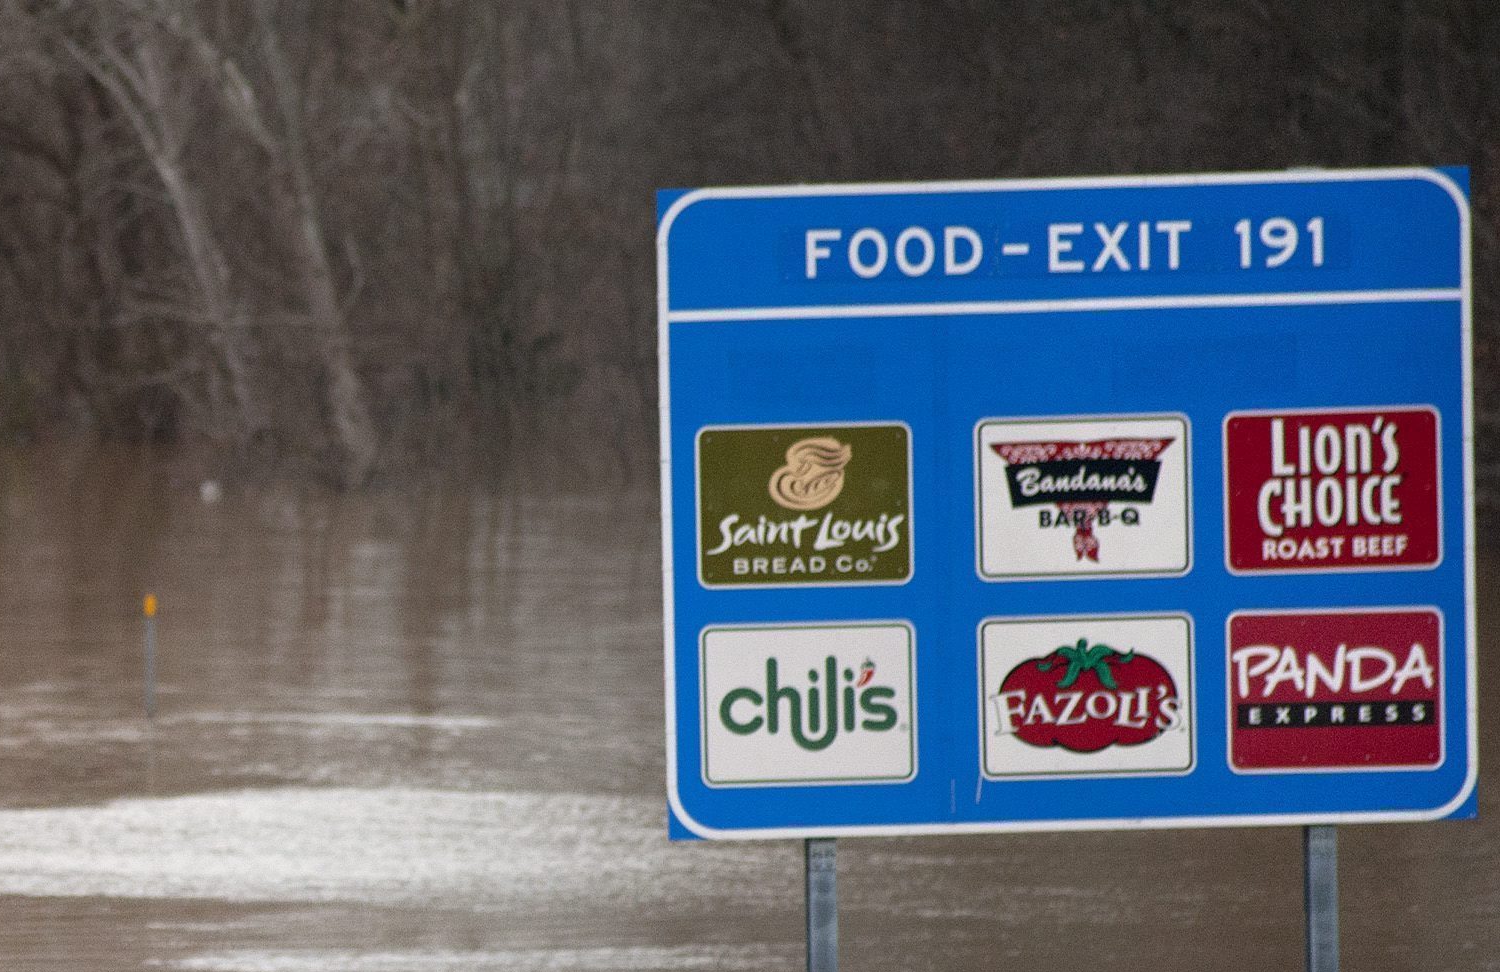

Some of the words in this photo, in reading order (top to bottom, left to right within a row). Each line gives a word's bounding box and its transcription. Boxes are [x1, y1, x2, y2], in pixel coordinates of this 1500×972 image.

[805, 226, 983, 280] FOOD
[1048, 220, 1192, 273] EXIT
[1234, 216, 1324, 269] 191
[1015, 466, 1148, 497] Bandana's
[1257, 474, 1402, 538] CHOICE
[707, 513, 820, 556] Saint
[814, 512, 905, 553] Louis
[1261, 537, 1345, 561] ROAST
[1352, 534, 1408, 558] BEEF
[733, 556, 826, 575] BREAD
[1232, 643, 1434, 699] PANDA
[719, 655, 898, 752] chili's
[989, 684, 1183, 735] FAZOLI'S
[1248, 703, 1426, 725] EXPRESS
